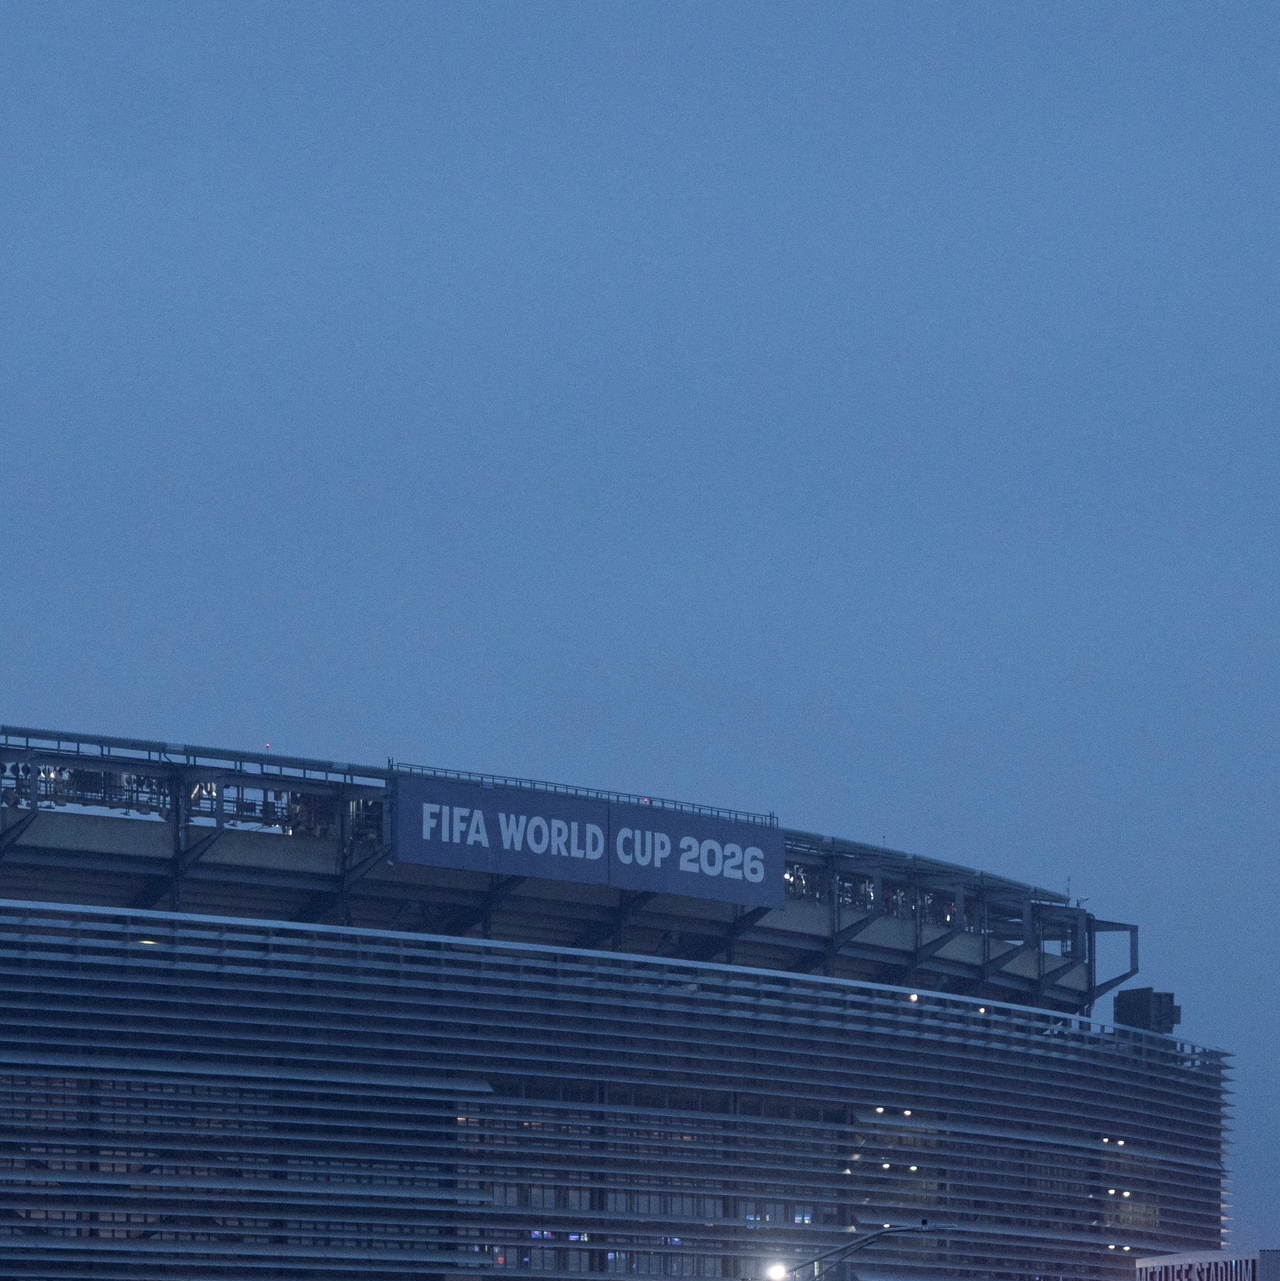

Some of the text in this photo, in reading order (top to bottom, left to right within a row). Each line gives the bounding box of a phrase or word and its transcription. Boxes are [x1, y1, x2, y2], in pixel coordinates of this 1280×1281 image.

[422, 803, 765, 883] FIFA WORLD CUP 2026
